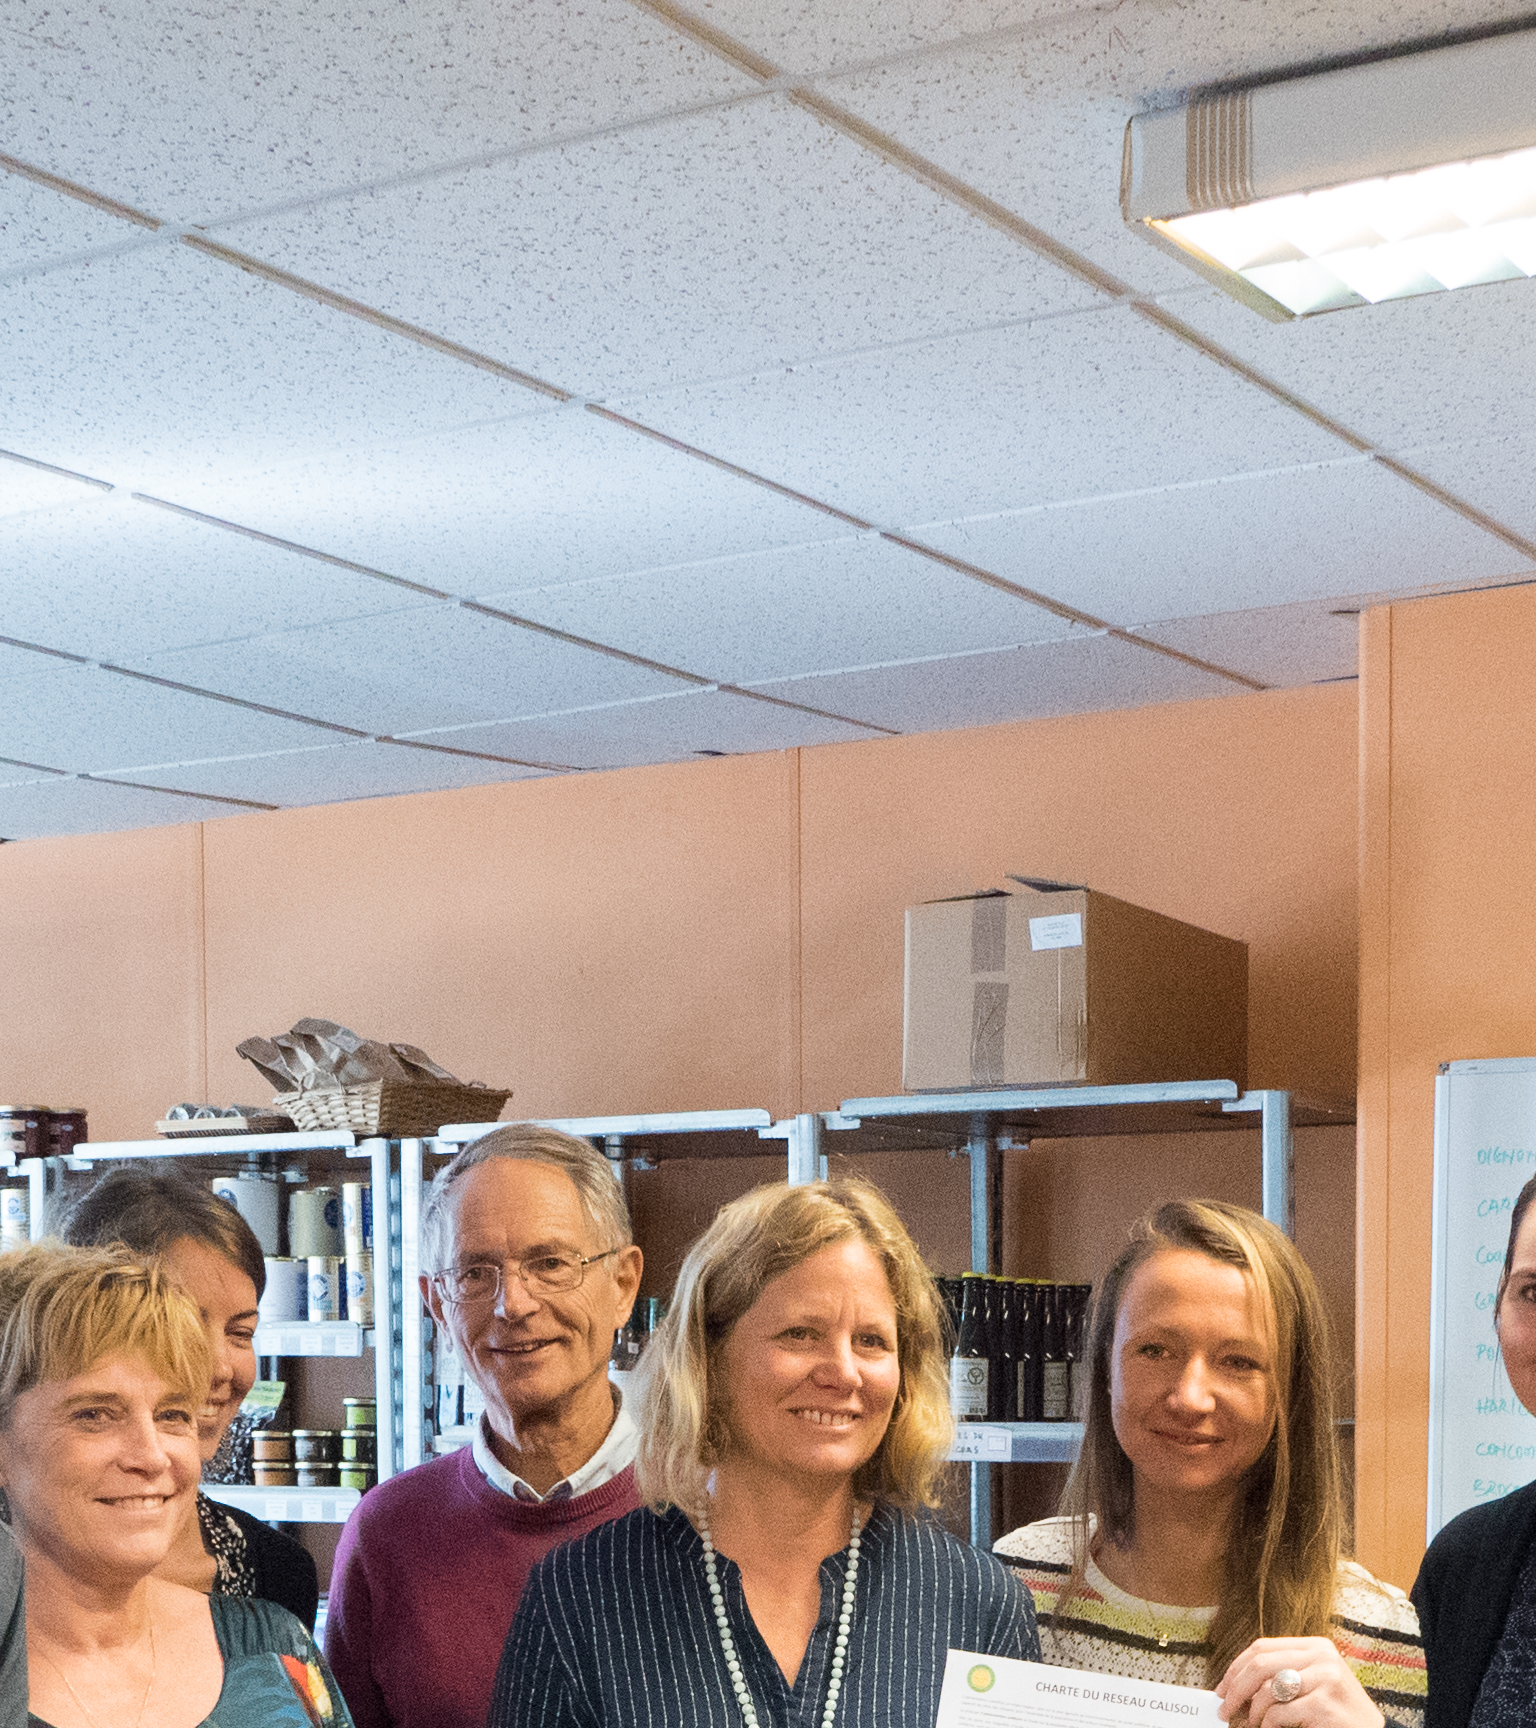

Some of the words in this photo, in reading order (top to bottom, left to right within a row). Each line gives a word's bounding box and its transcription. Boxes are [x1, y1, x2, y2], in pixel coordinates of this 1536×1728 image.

[1035, 1681, 1080, 1699] CHARTE
[1082, 1689, 1101, 1701] DU
[1102, 1692, 1147, 1709] RESEAU
[1149, 1699, 1200, 1717] CALISOLI
